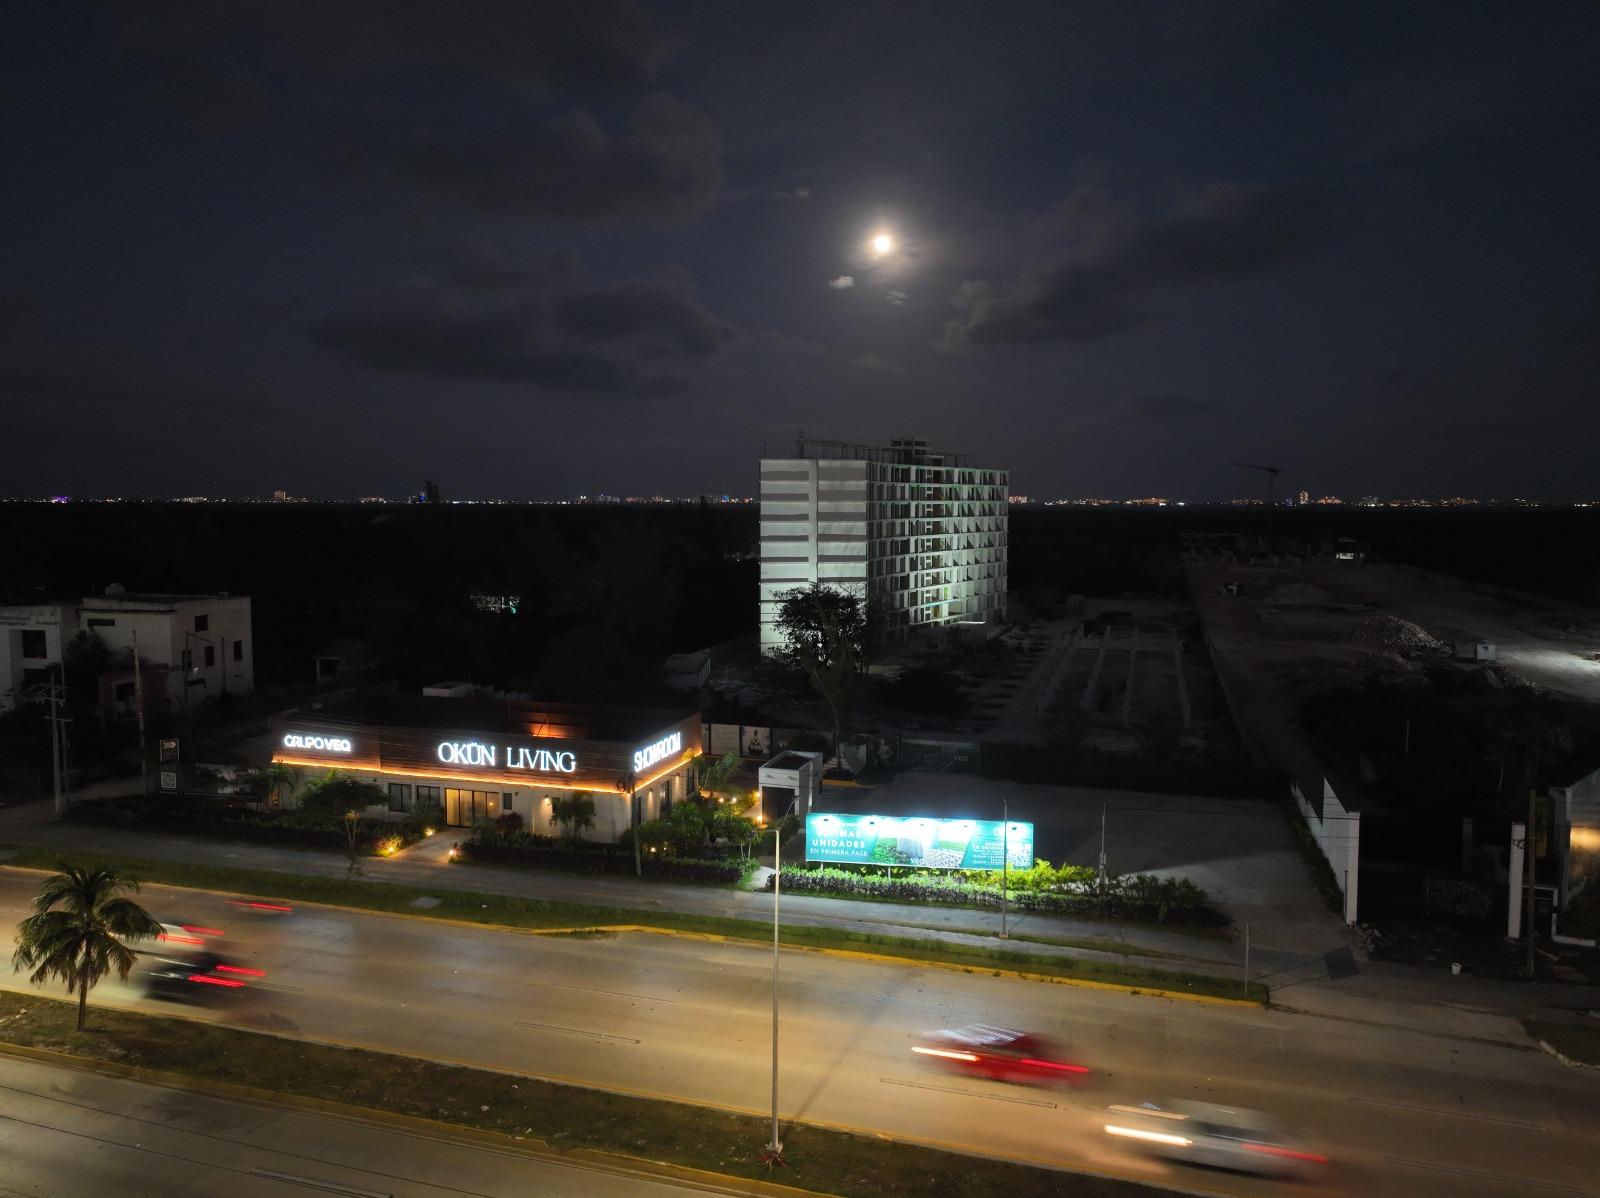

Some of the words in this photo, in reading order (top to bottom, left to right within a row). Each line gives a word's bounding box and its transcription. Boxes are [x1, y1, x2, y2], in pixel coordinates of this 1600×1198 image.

[438, 740, 496, 766] OKÜN
[507, 747, 577, 773] LIVING
[634, 731, 681, 772] SHOWROOM
[812, 838, 865, 848] UNIDADES
